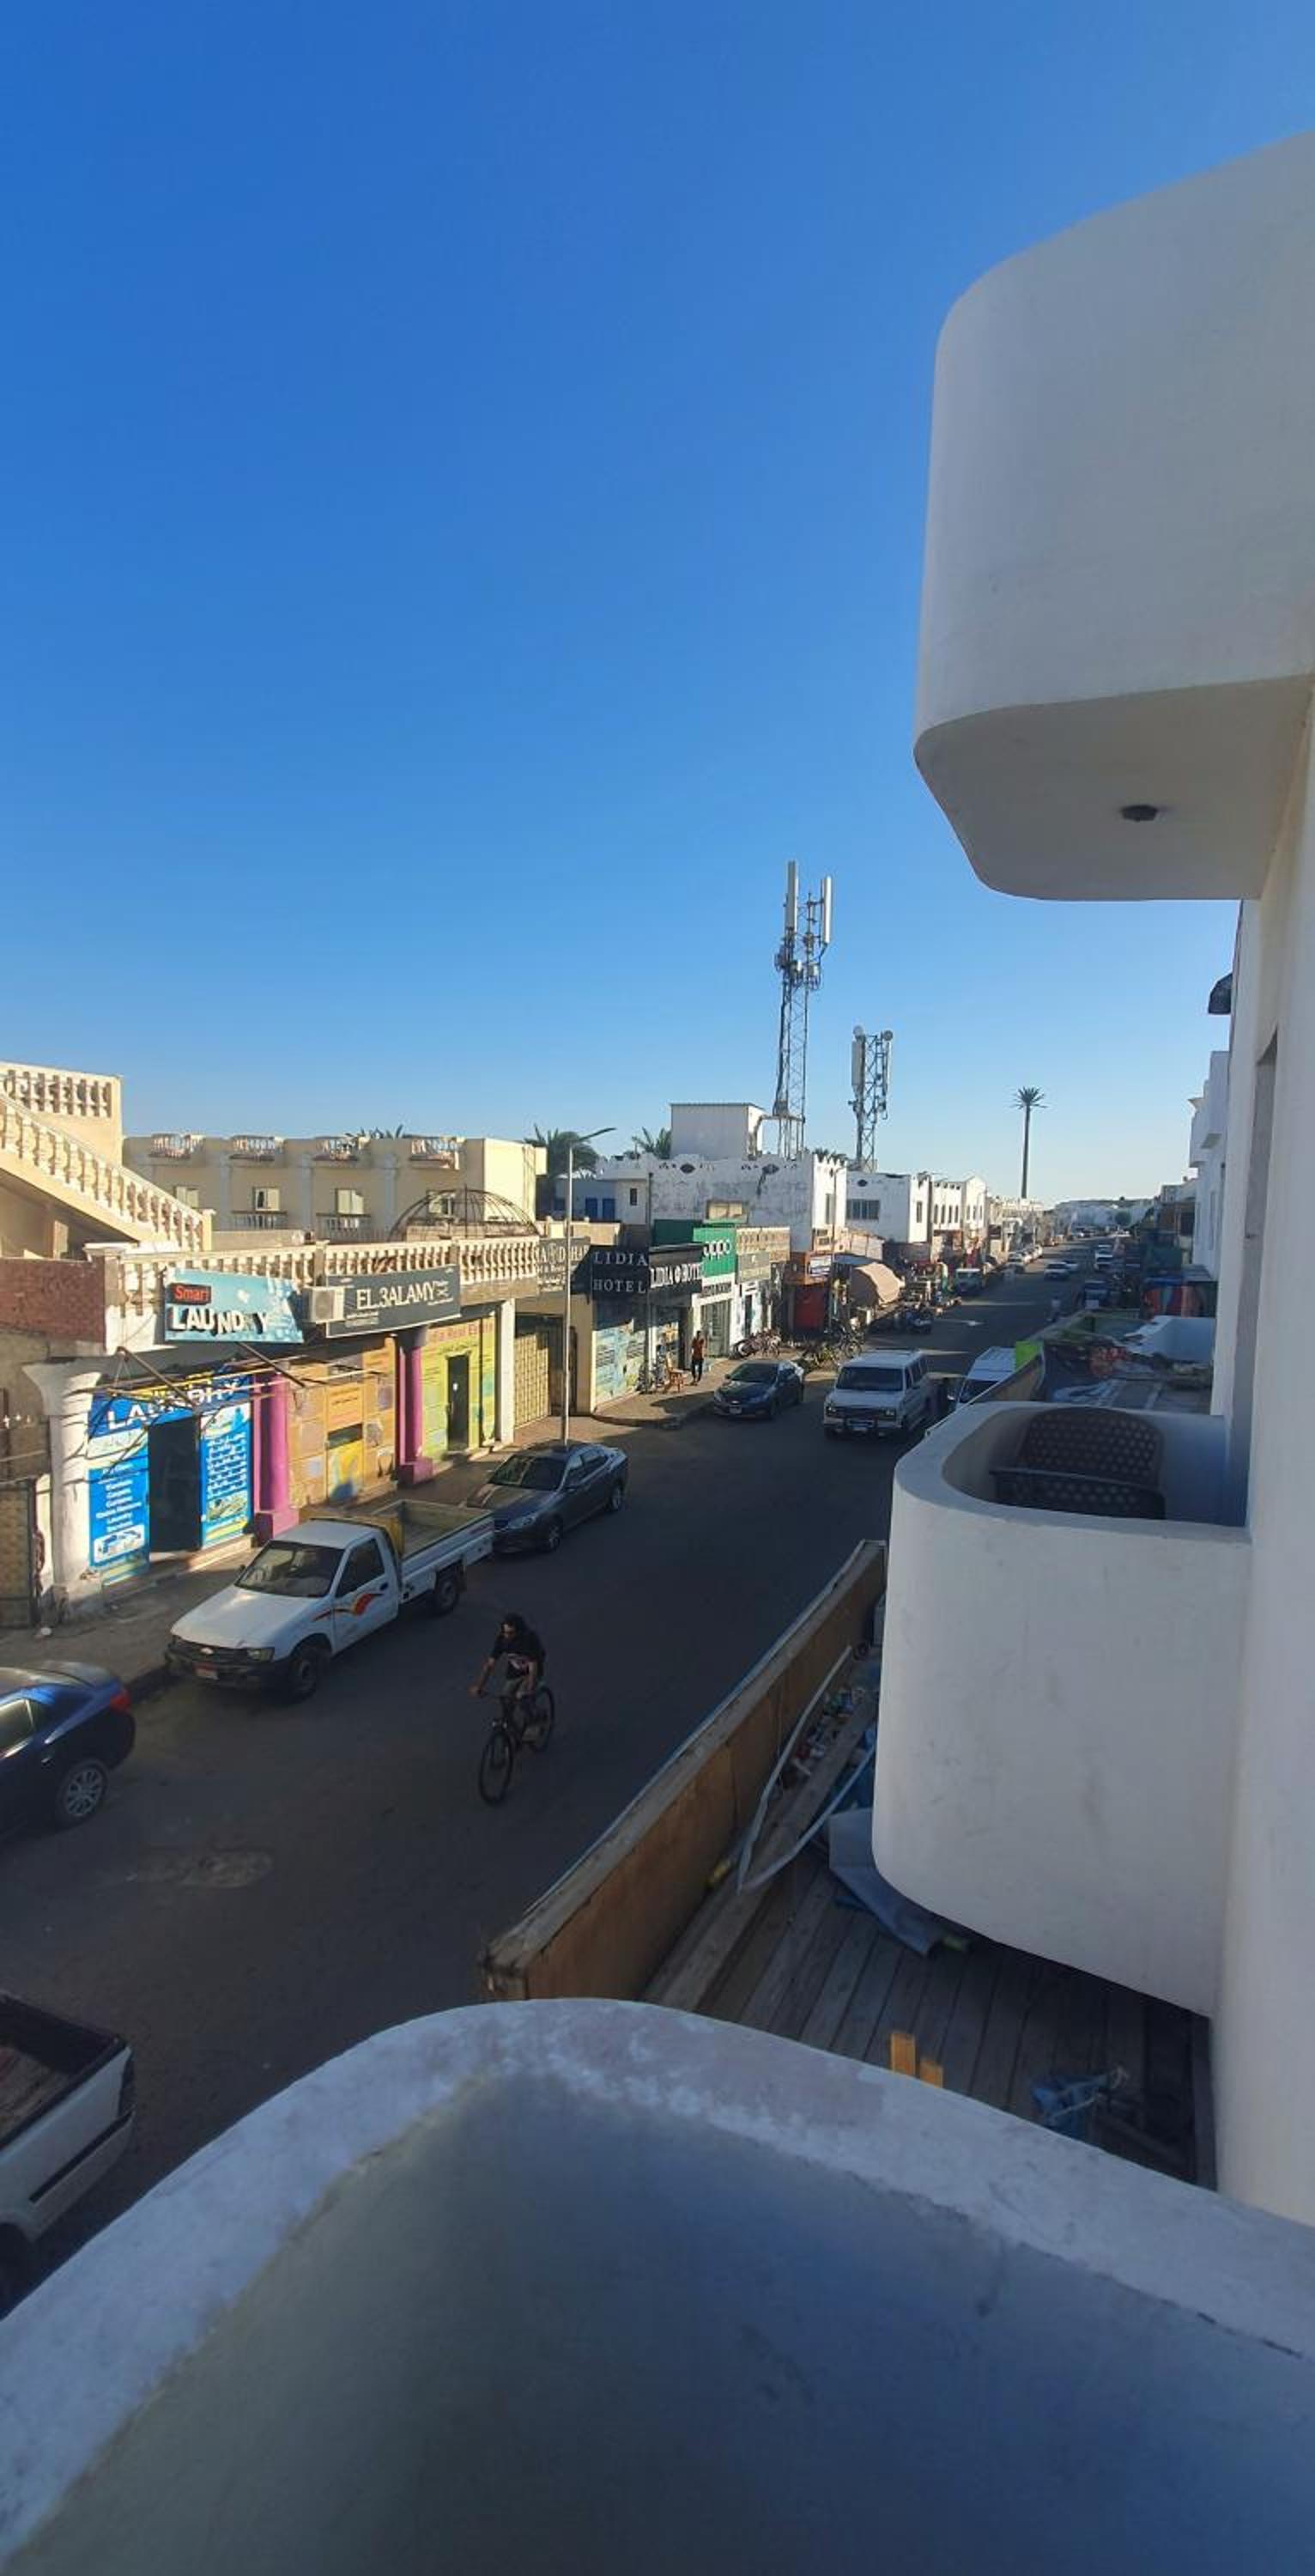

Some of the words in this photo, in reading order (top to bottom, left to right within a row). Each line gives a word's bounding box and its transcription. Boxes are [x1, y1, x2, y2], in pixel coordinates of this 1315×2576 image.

[594, 1252, 648, 1266] LIDIA
[650, 1267, 673, 1288] LIDIA
[593, 1279, 646, 1294] HOTEL
